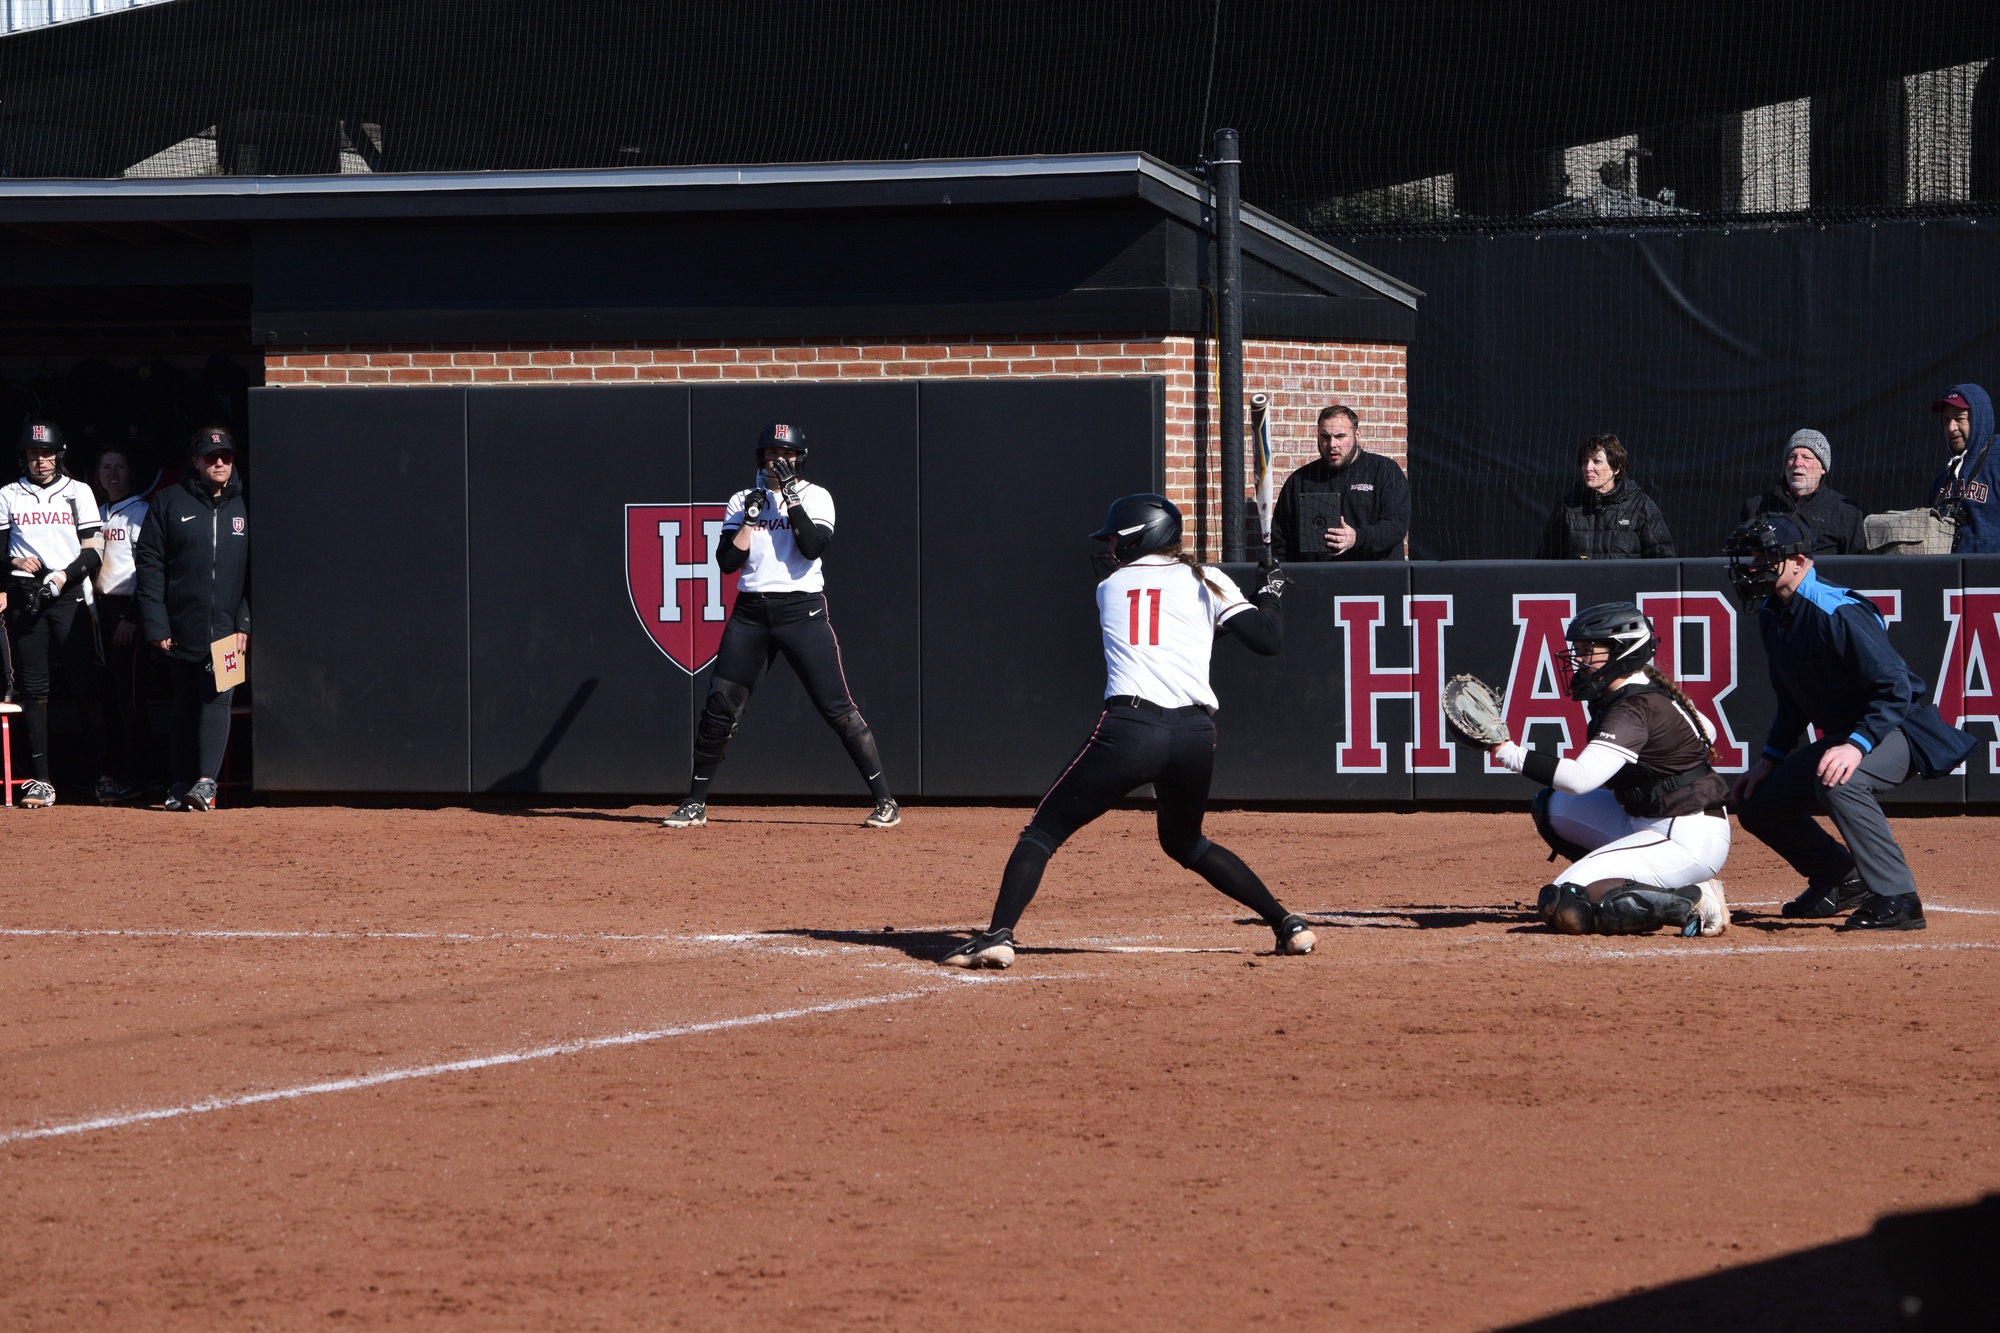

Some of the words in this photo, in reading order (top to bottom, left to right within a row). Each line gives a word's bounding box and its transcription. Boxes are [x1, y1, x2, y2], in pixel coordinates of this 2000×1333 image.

[33, 425, 46, 440] H
[775, 424, 789, 439] H
[658, 520, 726, 623] H
[1127, 588, 1162, 646] 11
[223, 649, 238, 675] H
